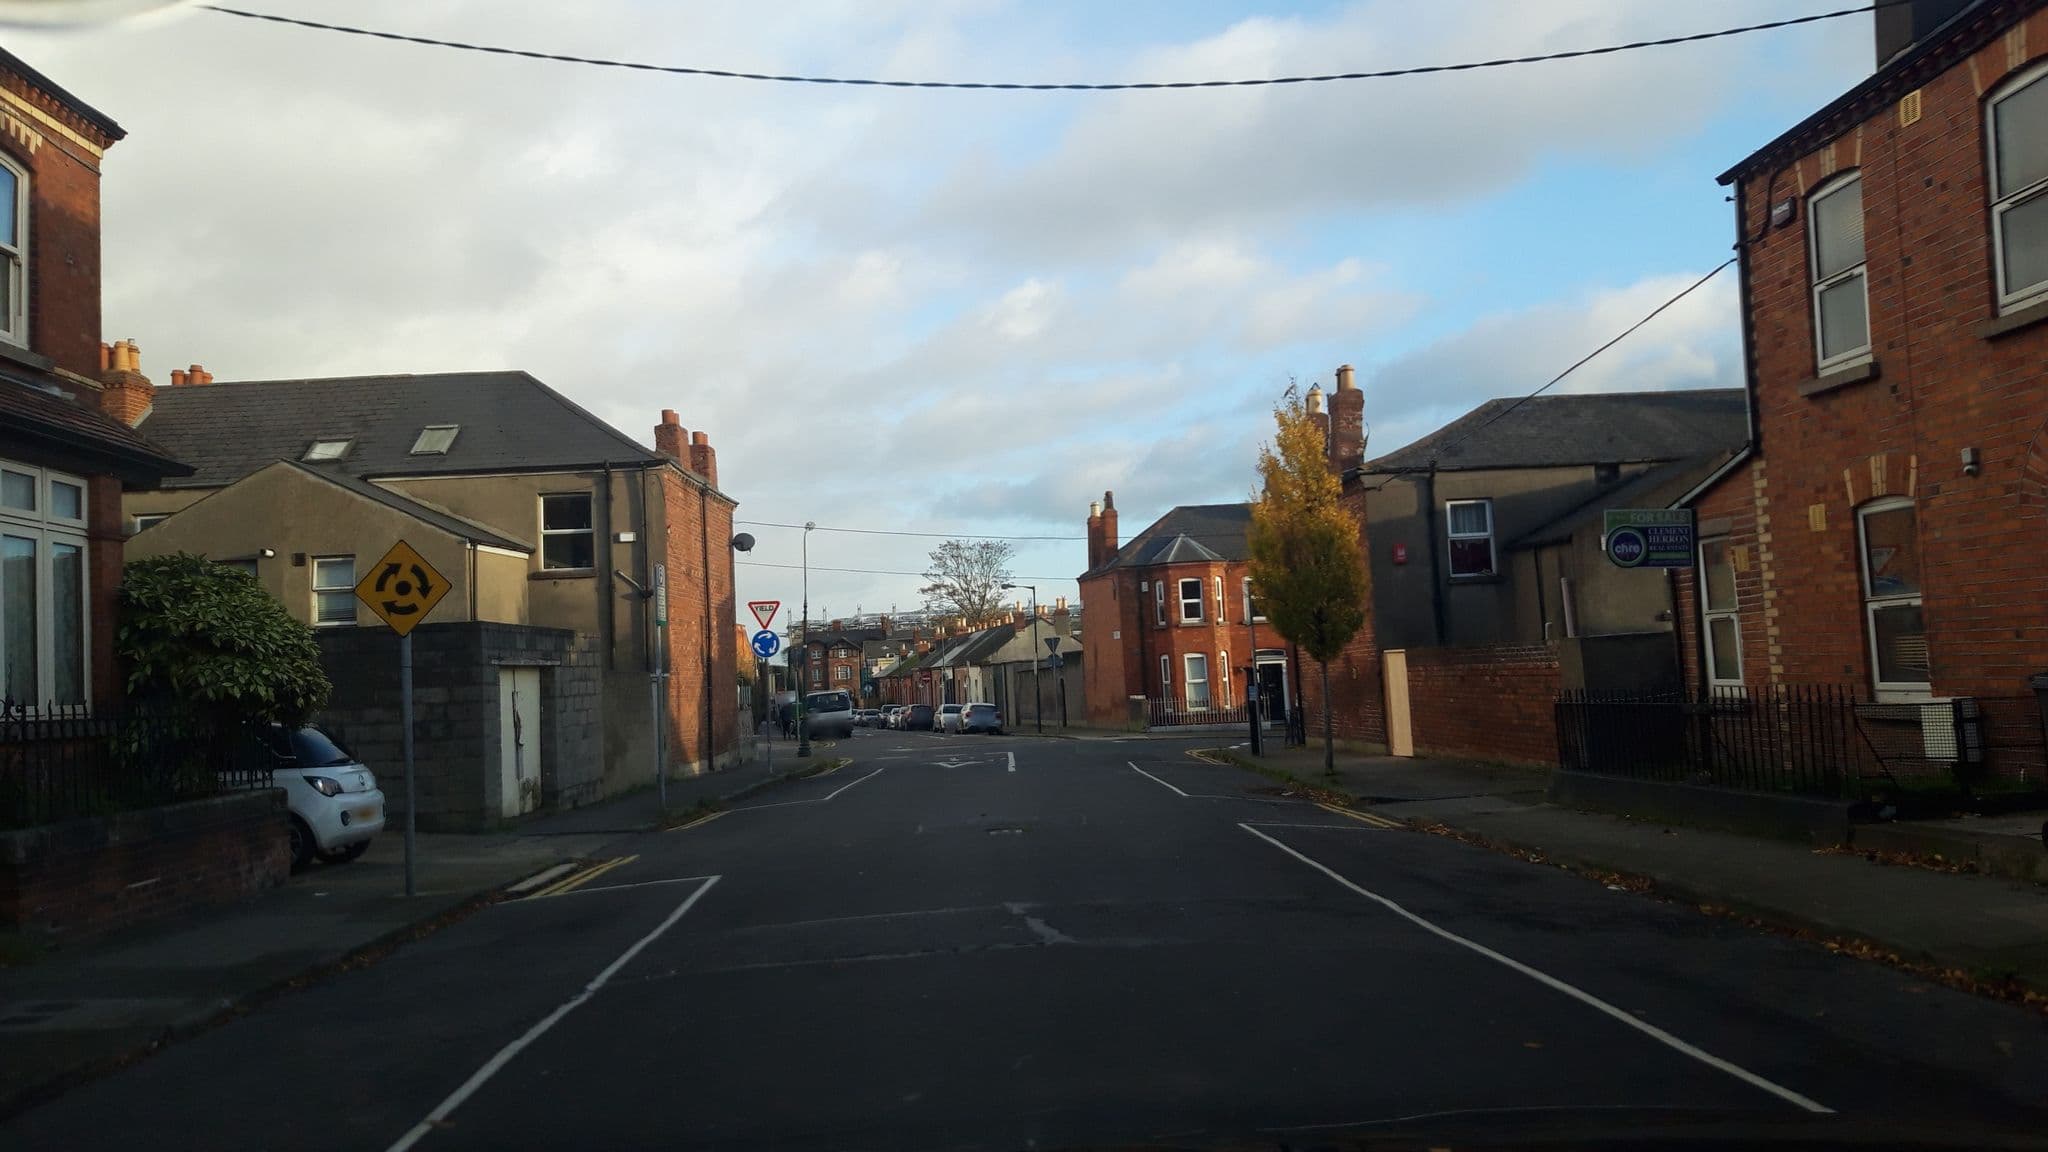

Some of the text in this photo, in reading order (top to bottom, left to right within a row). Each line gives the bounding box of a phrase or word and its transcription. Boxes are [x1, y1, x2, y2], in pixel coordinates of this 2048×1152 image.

[1630, 511, 1688, 522] FOR SALE
[1648, 527, 1689, 535] CLEMENT
[1648, 535, 1689, 543] HERRON
